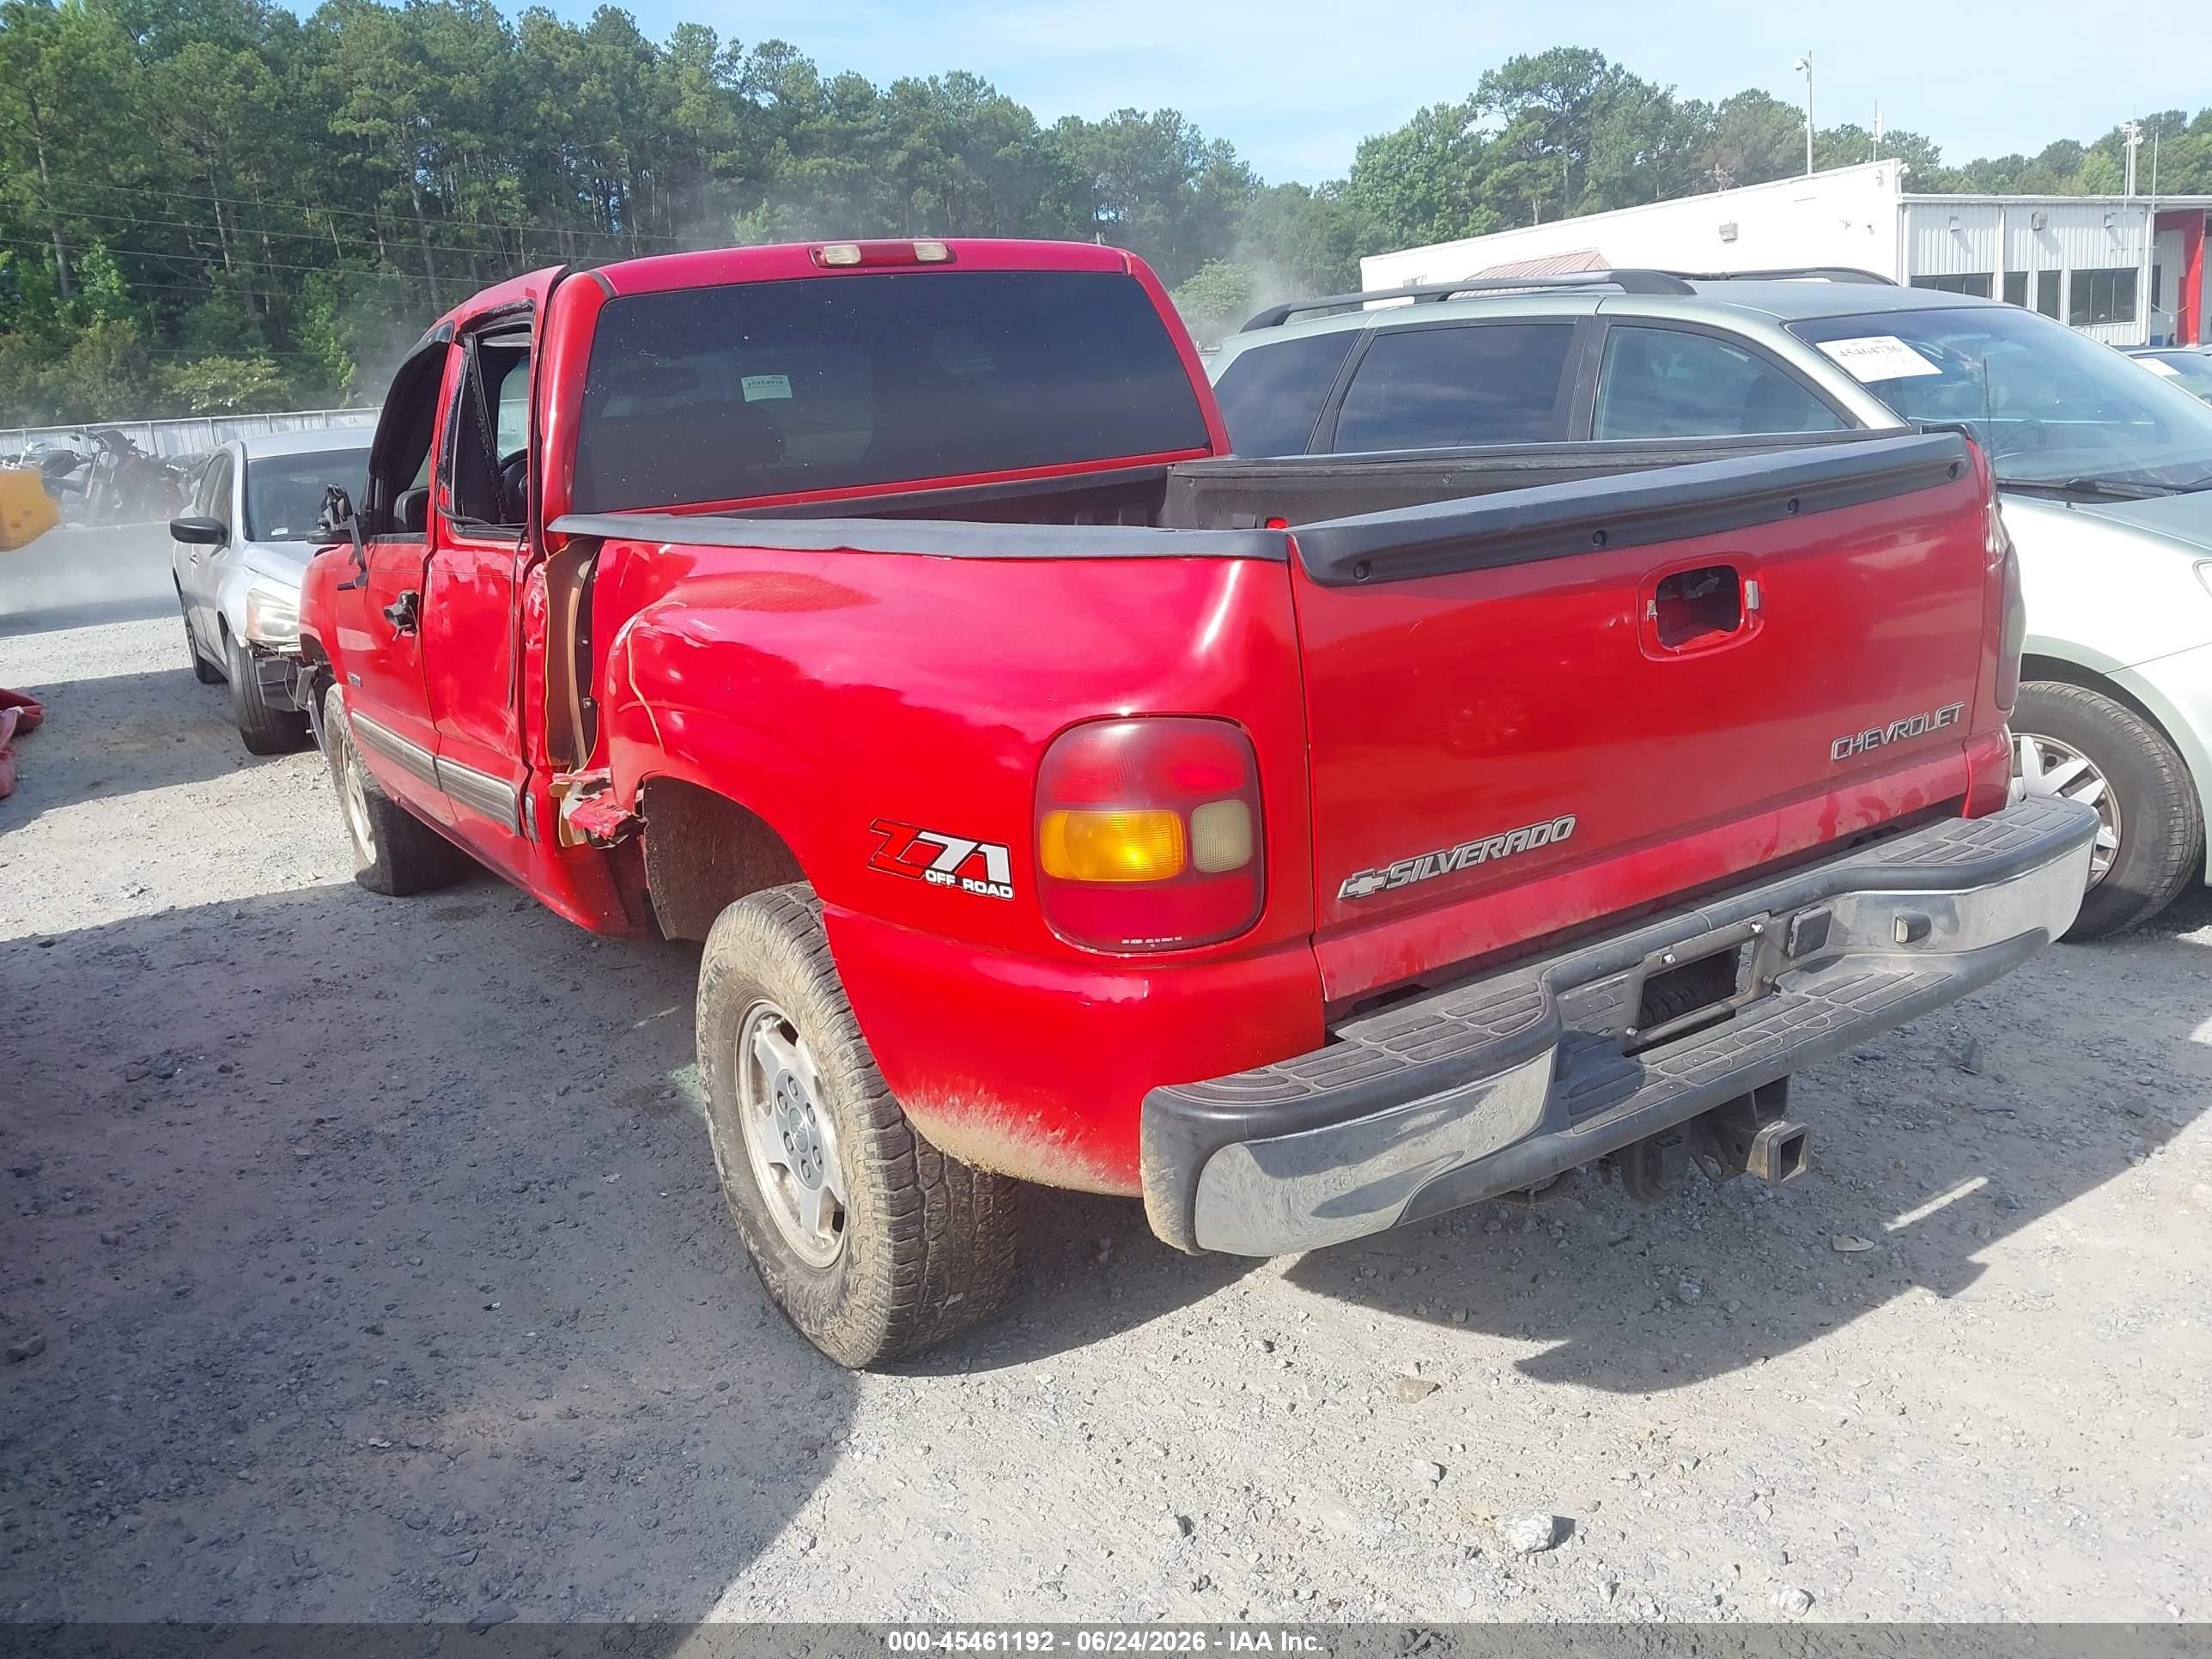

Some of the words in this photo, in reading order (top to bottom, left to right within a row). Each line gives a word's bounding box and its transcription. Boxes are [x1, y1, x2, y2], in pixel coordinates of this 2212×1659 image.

[1831, 701, 1966, 761] CHEVROLET
[1385, 814, 1577, 890] SILVERADO
[925, 869, 956, 887] OFF
[963, 878, 1013, 899] ROAD
